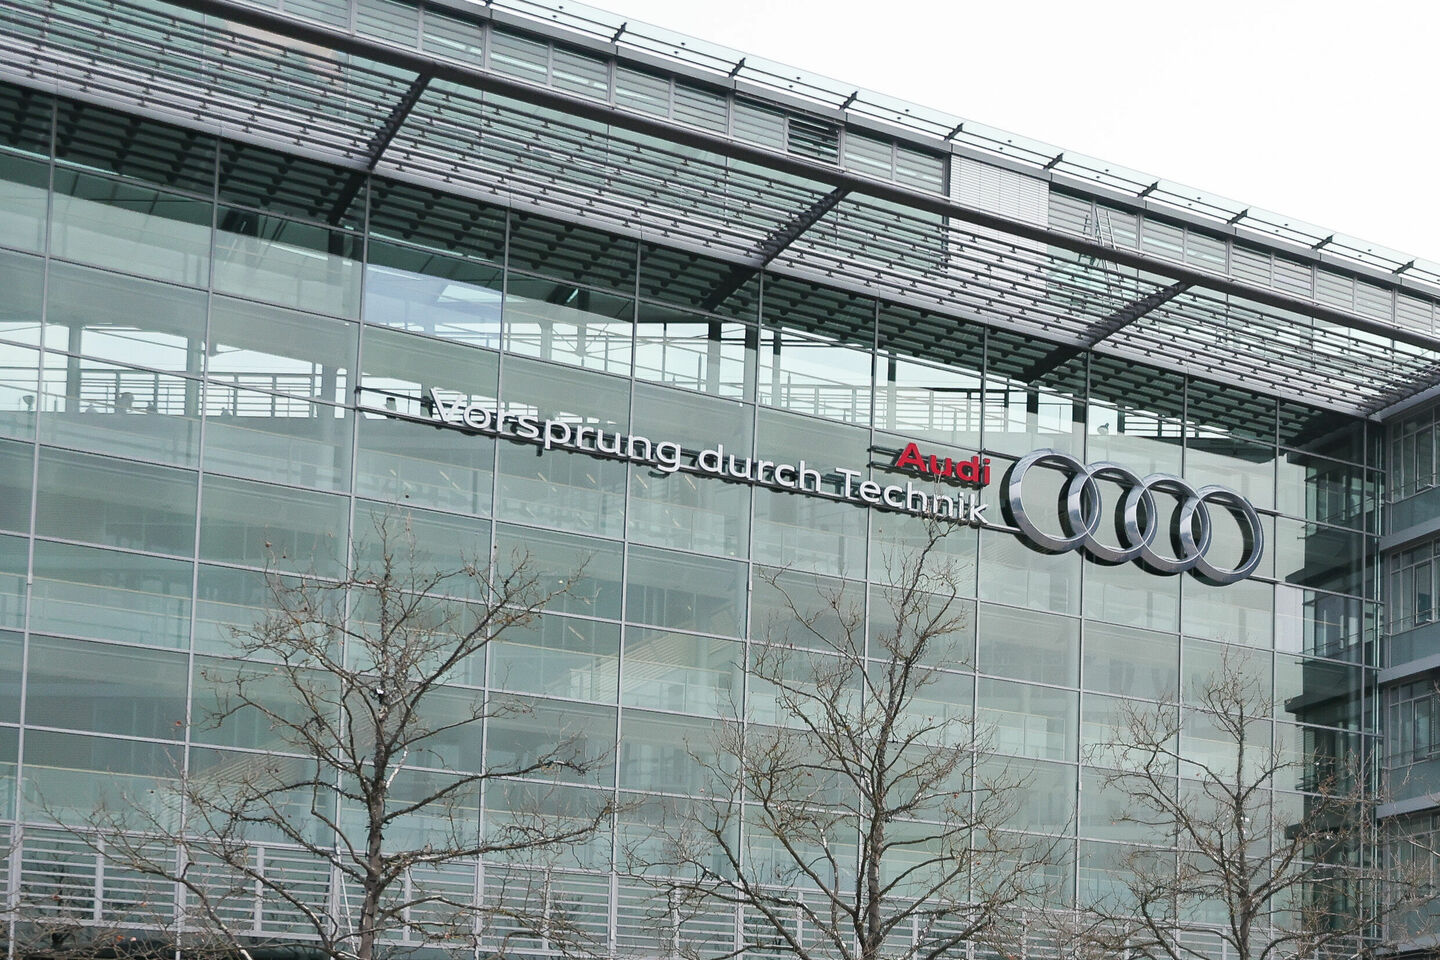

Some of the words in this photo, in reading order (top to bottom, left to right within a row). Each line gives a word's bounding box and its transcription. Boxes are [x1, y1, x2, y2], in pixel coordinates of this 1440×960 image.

[429, 386, 682, 473] Vorsprung
[698, 444, 822, 492] durch
[834, 467, 989, 524] Technik
[895, 442, 991, 485] Audi
